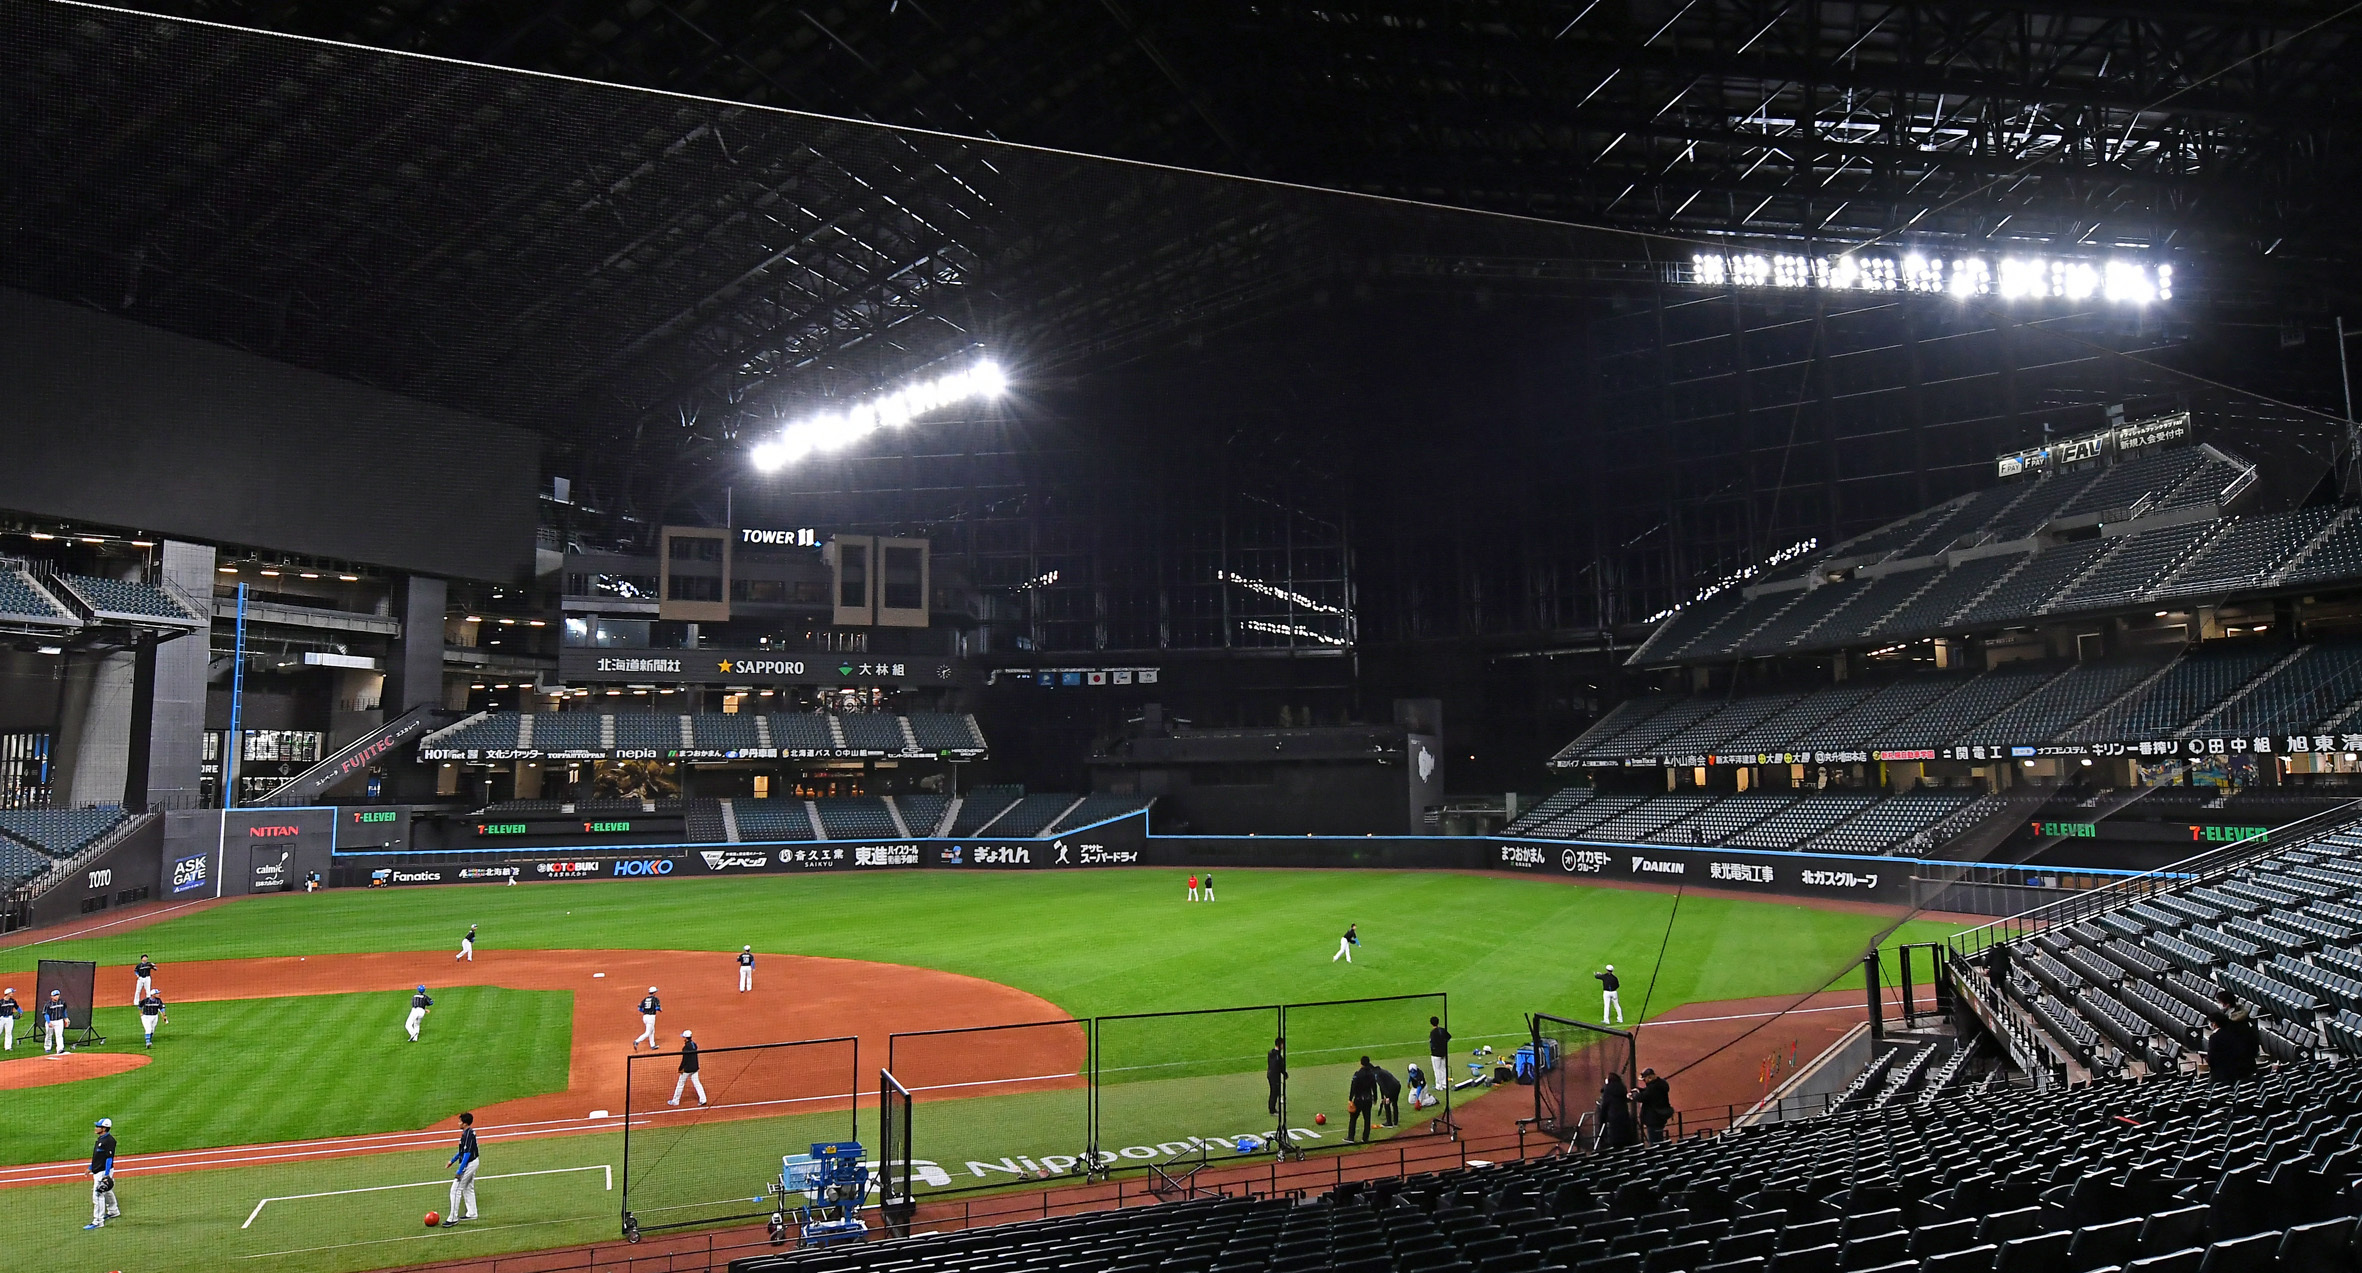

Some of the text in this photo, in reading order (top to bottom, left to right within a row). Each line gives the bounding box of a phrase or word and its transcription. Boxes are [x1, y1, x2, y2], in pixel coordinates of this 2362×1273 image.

[2120, 428, 2184, 450] 新規入会受付中
[2063, 440, 2101, 462] FAV
[742, 528, 815, 546] TOWER 11
[597, 658, 681, 673] 北海道新聞社
[736, 660, 804, 675] SAPPORO
[858, 663, 905, 677] 大林組
[2092, 740, 2178, 757] キリン一番搾り
[2208, 737, 2272, 754] 田中組
[341, 735, 395, 773] FUJITEC
[616, 748, 657, 760] nepia
[790, 750, 831, 758] 北海道バス
[1670, 755, 1707, 767] 小山商会
[354, 811, 396, 823] 7-ELEVEN
[250, 826, 299, 837] NITTAN
[478, 824, 526, 835] 7-ELEVEN
[584, 821, 630, 832] 7-ELEVEN
[2031, 822, 2096, 837] 7-ELEVEN
[855, 845, 919, 866] 東進 ハイスクール
[974, 846, 1030, 864] ぎょれん
[1080, 844, 1104, 853] アサヒ
[1501, 846, 1546, 864] まつおかまん
[715, 857, 767, 870] ジーベック
[1080, 852, 1138, 864] スーパードライ
[1576, 850, 1612, 865] オカモト
[174, 856, 206, 875] ASK
[547, 860, 599, 873] KOTOBUKI
[614, 859, 673, 876] HOKKO
[1577, 863, 1600, 873] グループ
[1642, 859, 1685, 874] DAIKIN
[1710, 862, 1774, 884] 東光電気工事
[88, 868, 111, 889] TOTO
[173, 868, 206, 885] GATE
[393, 870, 441, 882] Fanatics
[1801, 870, 1878, 889] 北ガスグループ
